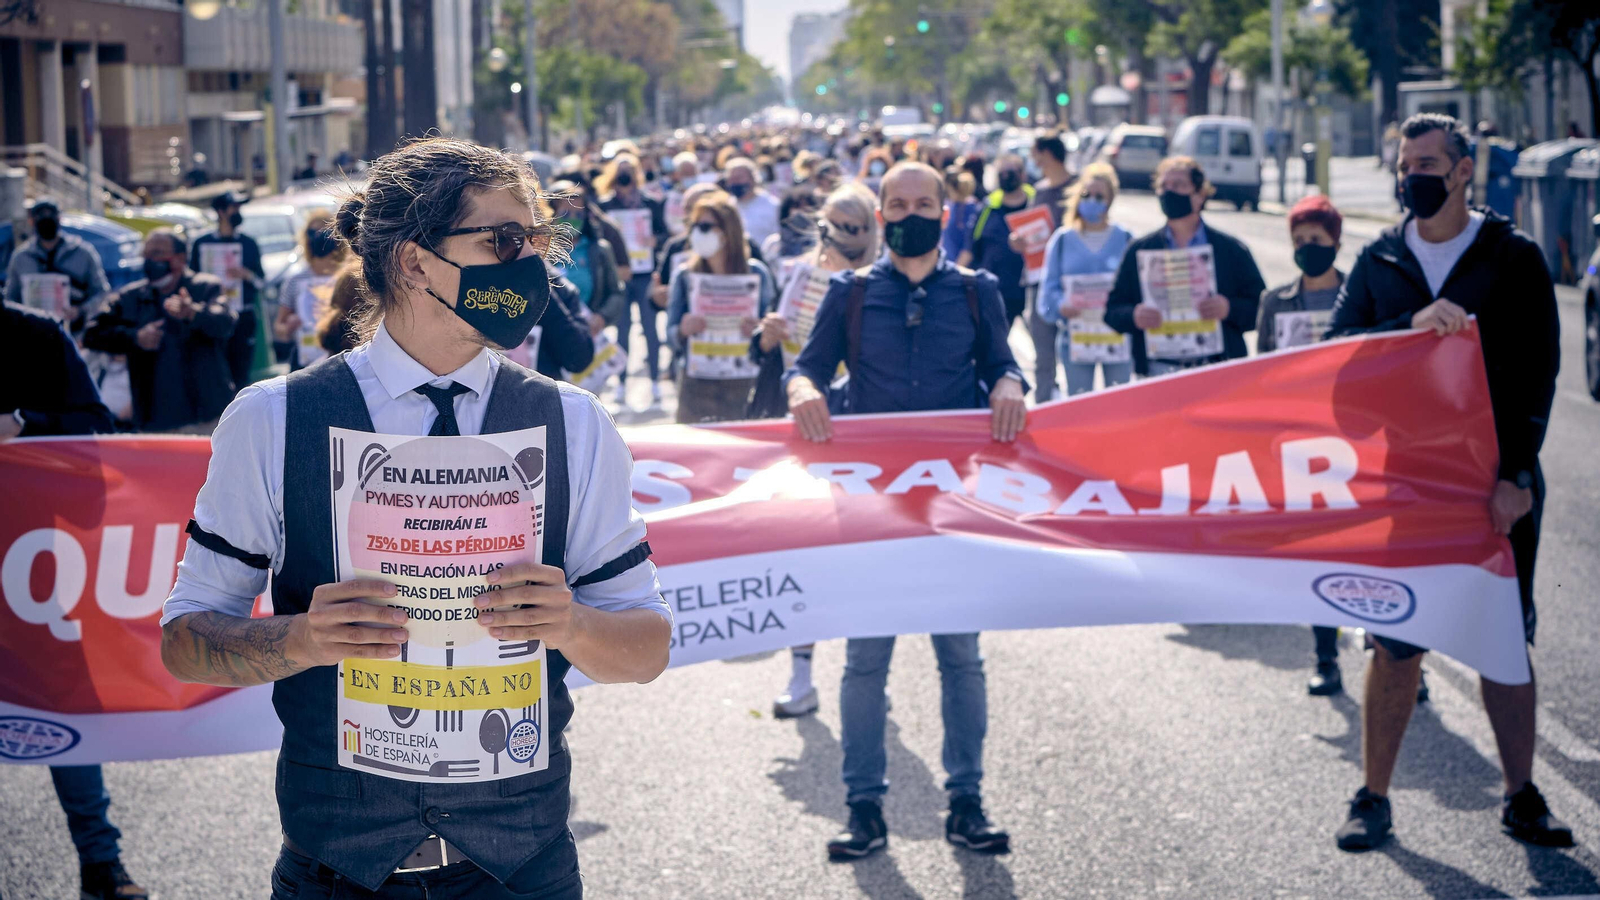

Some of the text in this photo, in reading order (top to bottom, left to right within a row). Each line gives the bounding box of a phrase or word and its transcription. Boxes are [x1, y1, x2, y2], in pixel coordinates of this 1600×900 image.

[383, 465, 510, 485] EN ALEMANIA
[733, 436, 1359, 516] RABAJAR
[366, 490, 520, 509] PYMES Y AUTONÓMOS
[403, 517, 488, 530] RECIBIRÁN EL
[367, 533, 526, 553] 75% DE LAS PÉRDIDAS
[380, 562, 398, 575] EN
[400, 563, 465, 578] RELACIÓN
[467, 565, 477, 576] A
[430, 588, 455, 600] DEL
[445, 609, 463, 621] DE
[350, 668, 533, 698] EN ESPAÑA NO
[364, 727, 439, 749] HOSTELERÍA
[511, 734, 537, 748] HORECA
[365, 744, 431, 766] DE ESPAÑA
